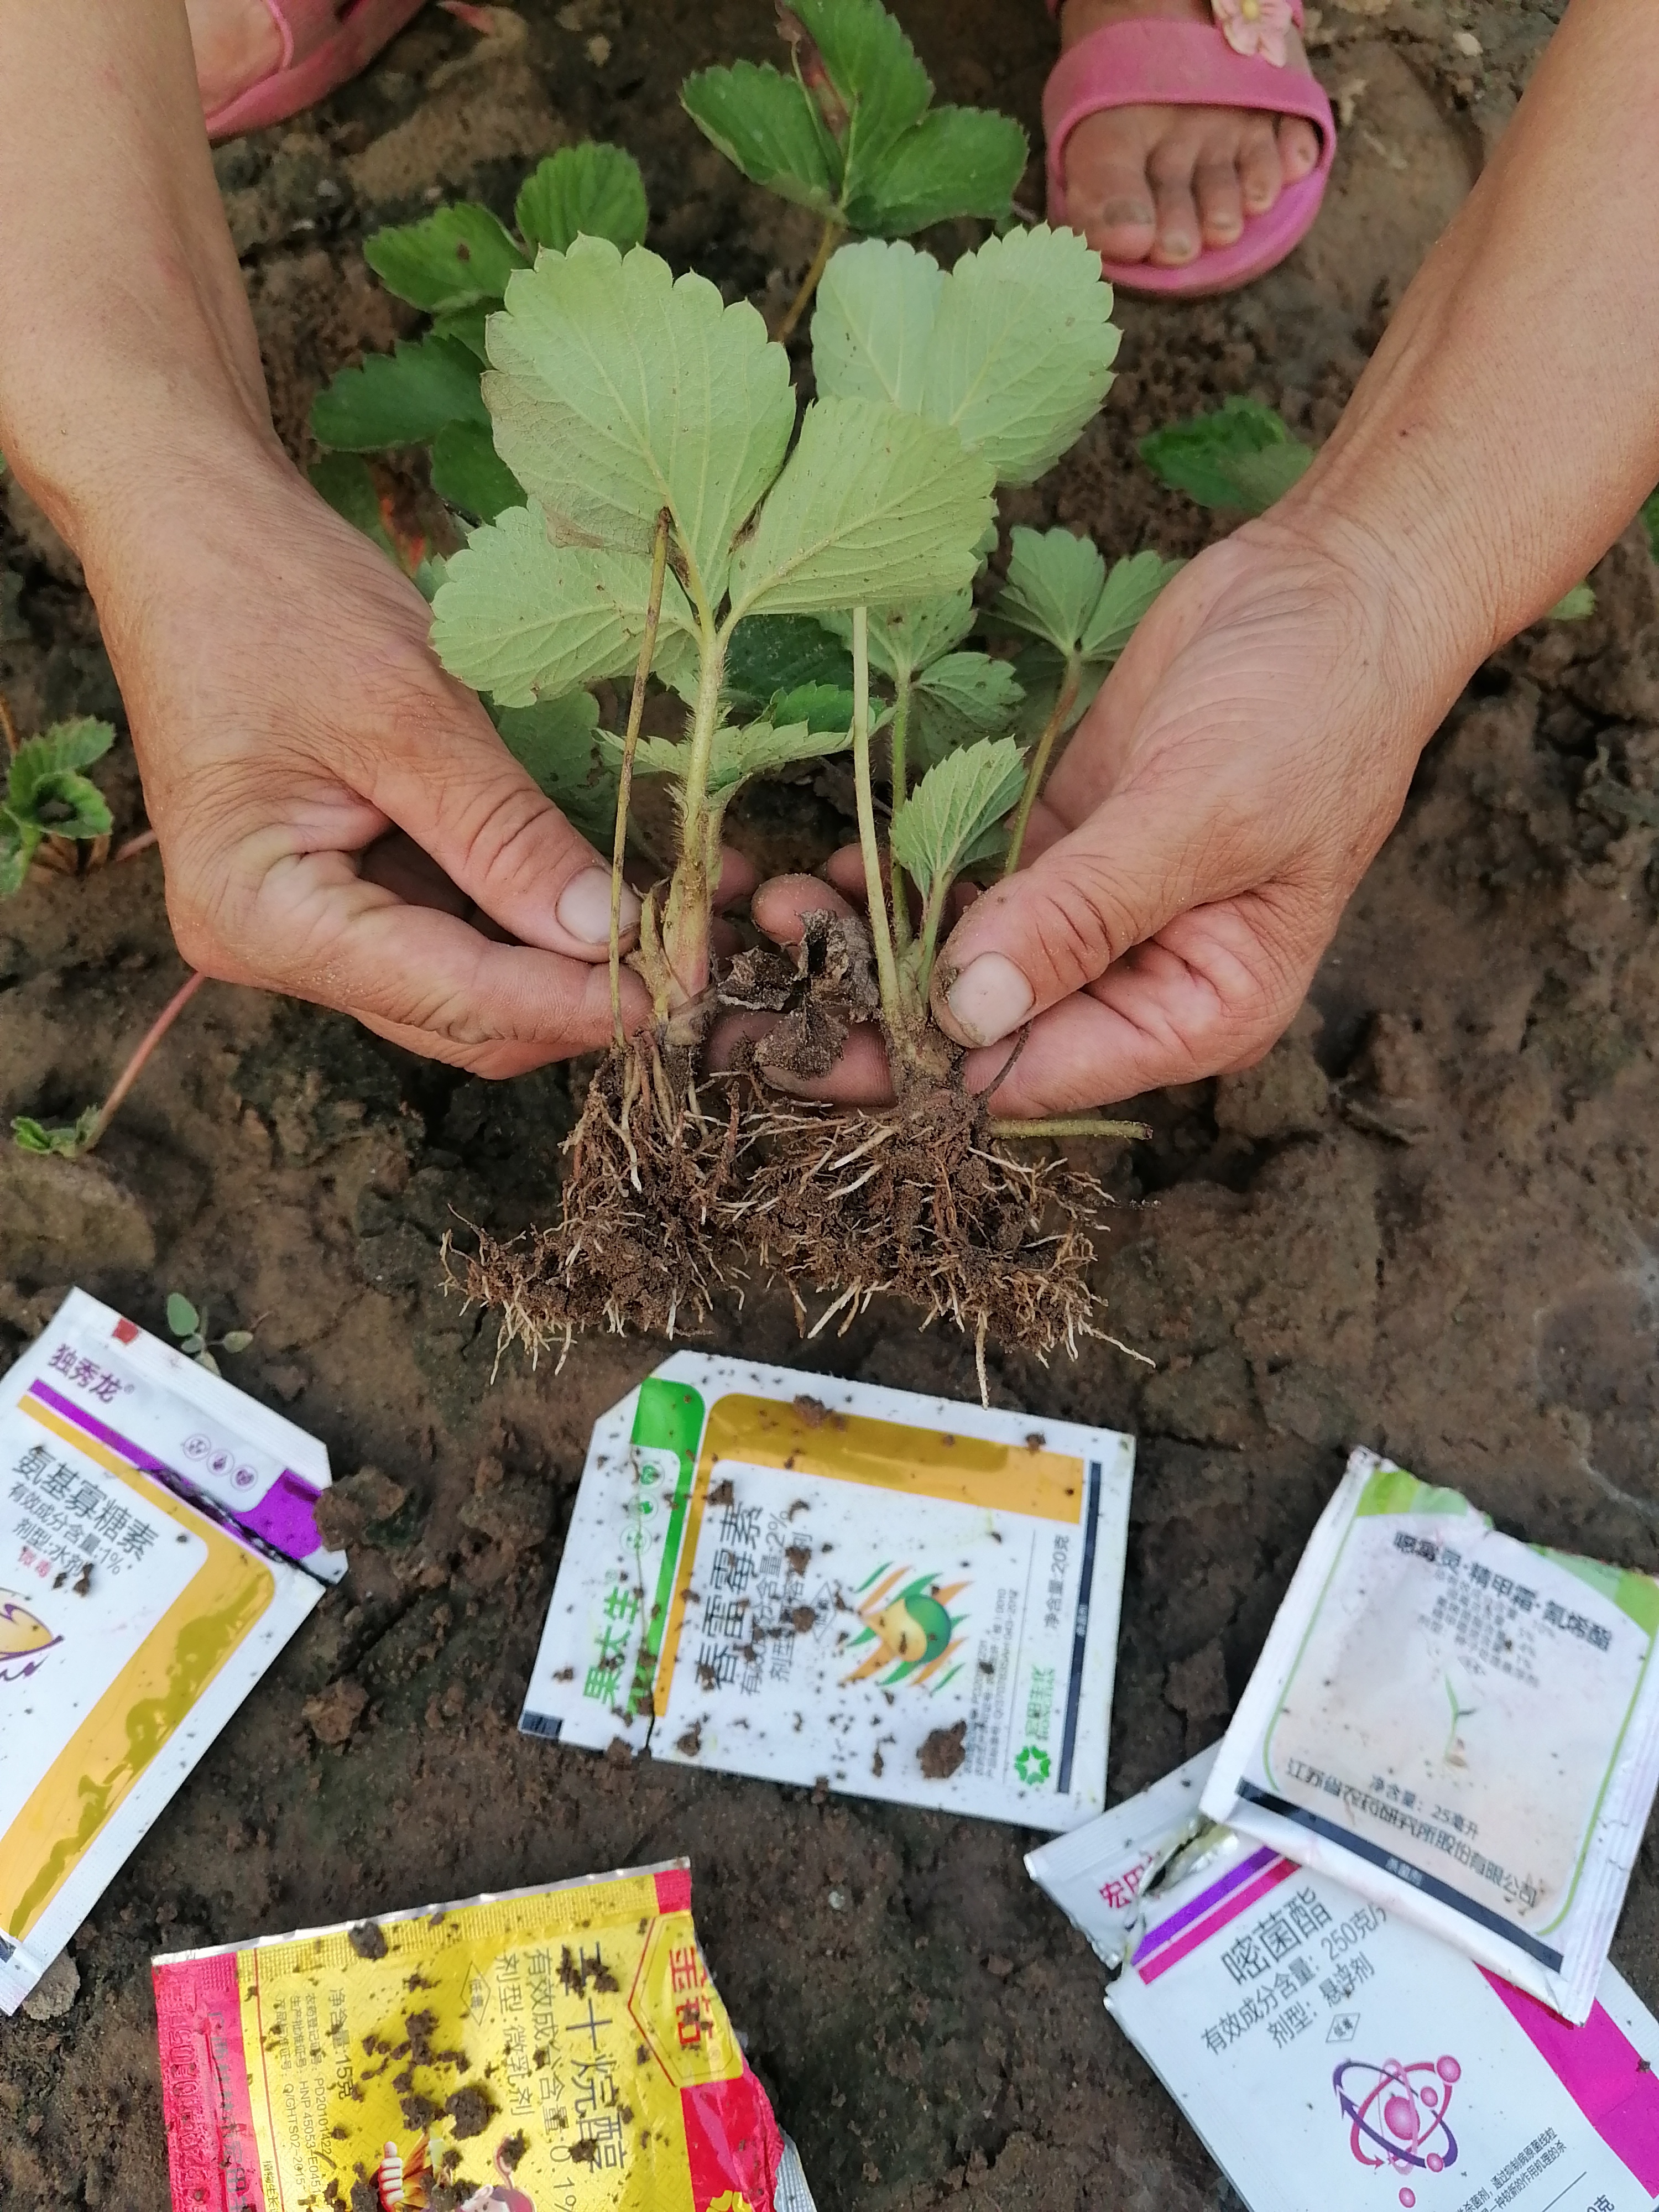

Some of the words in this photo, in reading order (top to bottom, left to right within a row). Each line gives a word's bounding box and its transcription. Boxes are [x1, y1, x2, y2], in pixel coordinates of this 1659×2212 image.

[48, 1343, 122, 1404] 独秀龙
[9, 1481, 123, 1575] 有效成分含量:1%
[12, 1446, 159, 1561] 氨基寡糖素
[13, 1518, 84, 1577] 剂型:水剂
[693, 1502, 764, 1690] 春雷霉素
[1042, 1533, 1070, 1630] 净含量:20克
[583, 1586, 640, 1705] 果大生
[1219, 1884, 1333, 1986] 嘧菌酯
[325, 1987, 357, 2099] 净含量:15克
[492, 1953, 536, 2117] 剂型:微乳剂
[1267, 1950, 1376, 2049] 剂型：悬浮剂
[262, 2159, 279, 2212] 植物生长
[1457, 2127, 1557, 2212] 杀菌剂，通过抑制病原菌线粒
